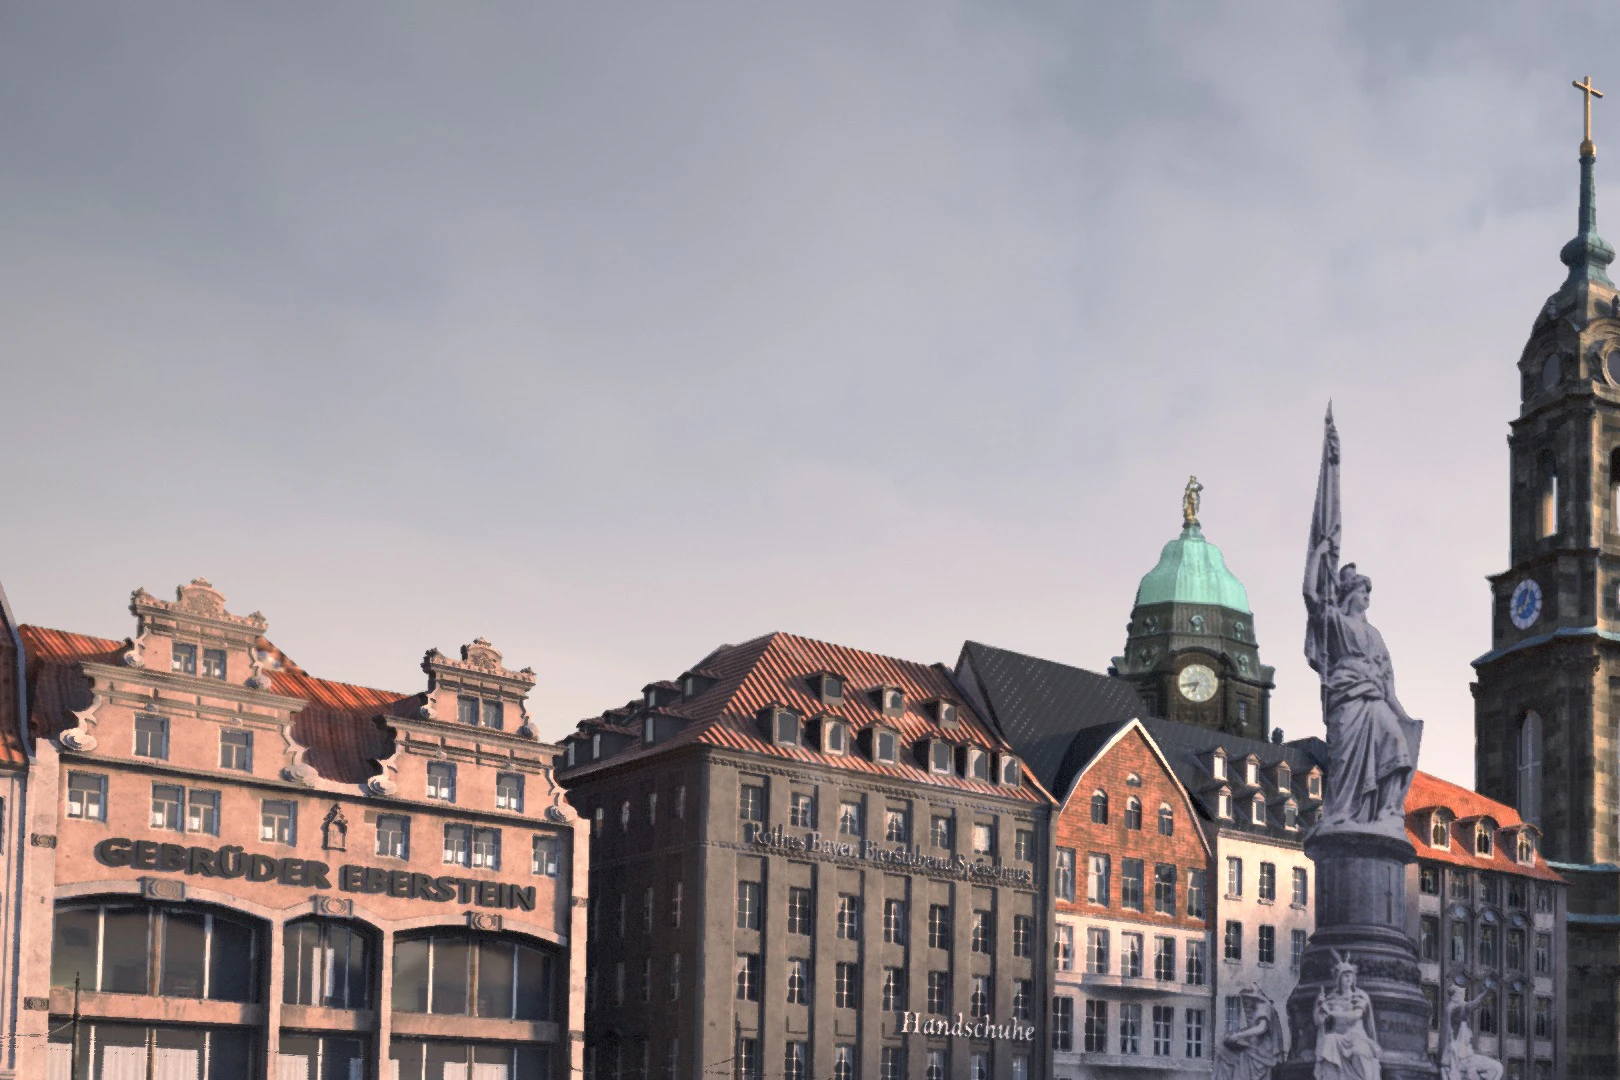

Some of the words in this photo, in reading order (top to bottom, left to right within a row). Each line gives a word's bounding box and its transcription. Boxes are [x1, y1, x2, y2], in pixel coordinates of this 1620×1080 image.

[94, 837, 331, 889] GEBRÜDER
[338, 864, 537, 912] EBERSTEIN
[901, 1011, 1035, 1041] Handschuhe
